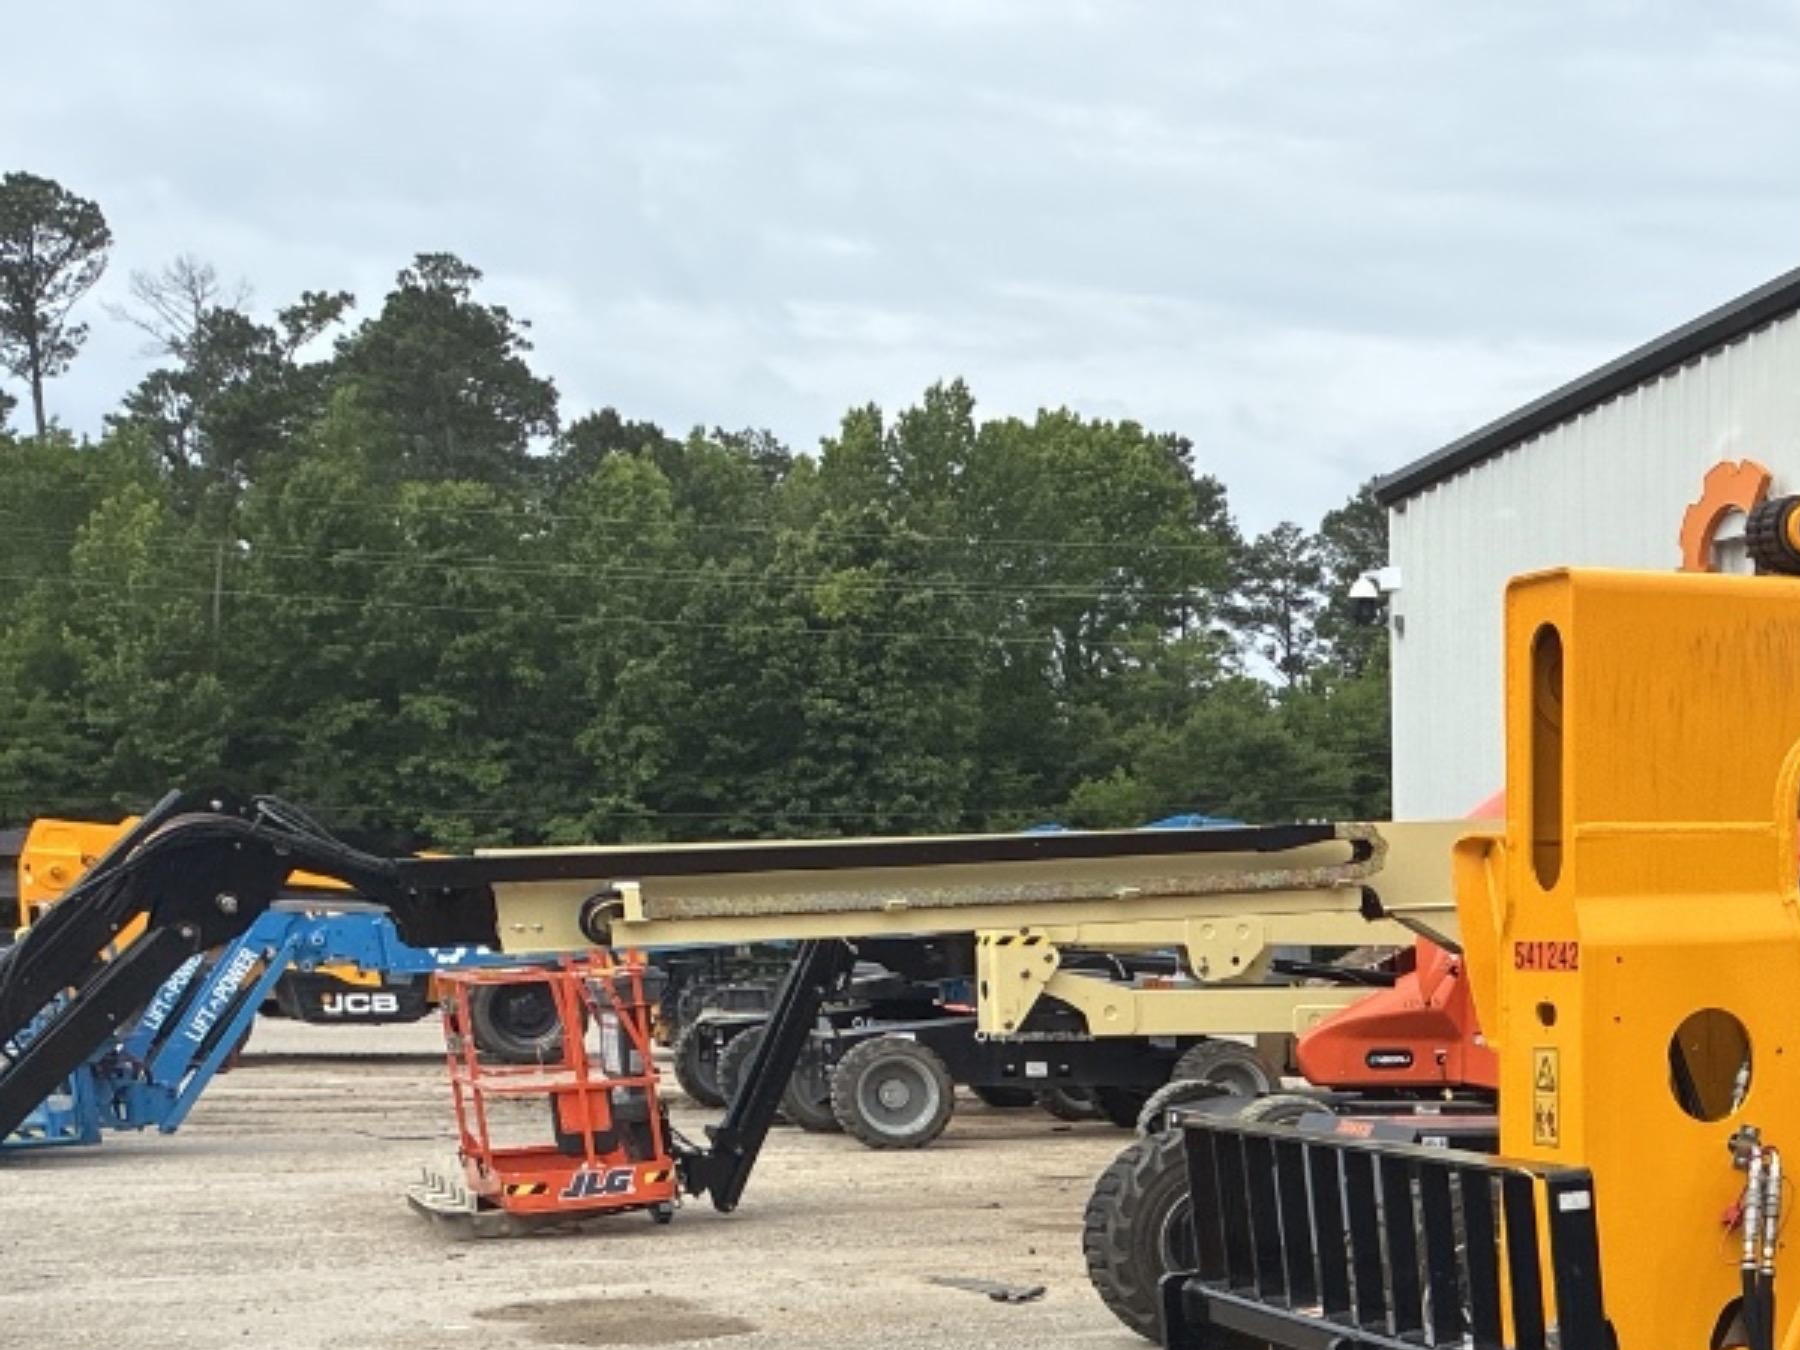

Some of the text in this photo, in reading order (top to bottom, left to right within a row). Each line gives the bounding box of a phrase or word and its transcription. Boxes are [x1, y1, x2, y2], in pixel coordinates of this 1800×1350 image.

[1514, 941, 1579, 970] 541242
[322, 991, 400, 1014] JCB
[558, 1166, 635, 1201] JLG
